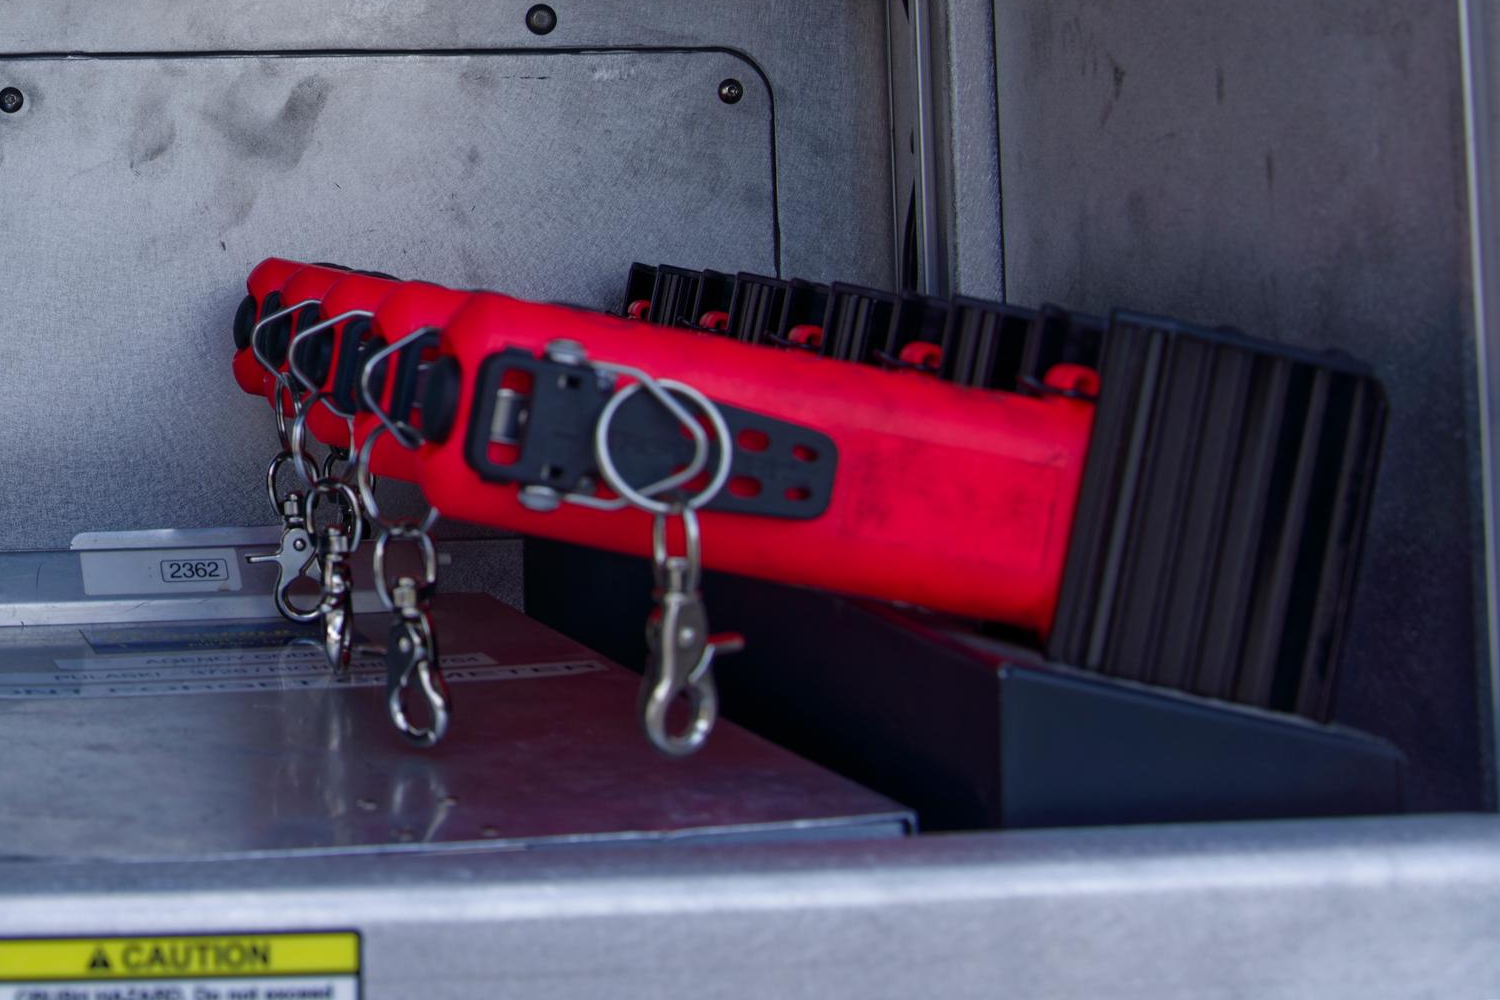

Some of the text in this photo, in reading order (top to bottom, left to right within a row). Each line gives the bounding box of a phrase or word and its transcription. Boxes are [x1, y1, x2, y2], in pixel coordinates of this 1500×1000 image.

[170, 561, 220, 579] 2362
[54, 671, 161, 680] PULASKI
[121, 943, 272, 970] CAUTION
